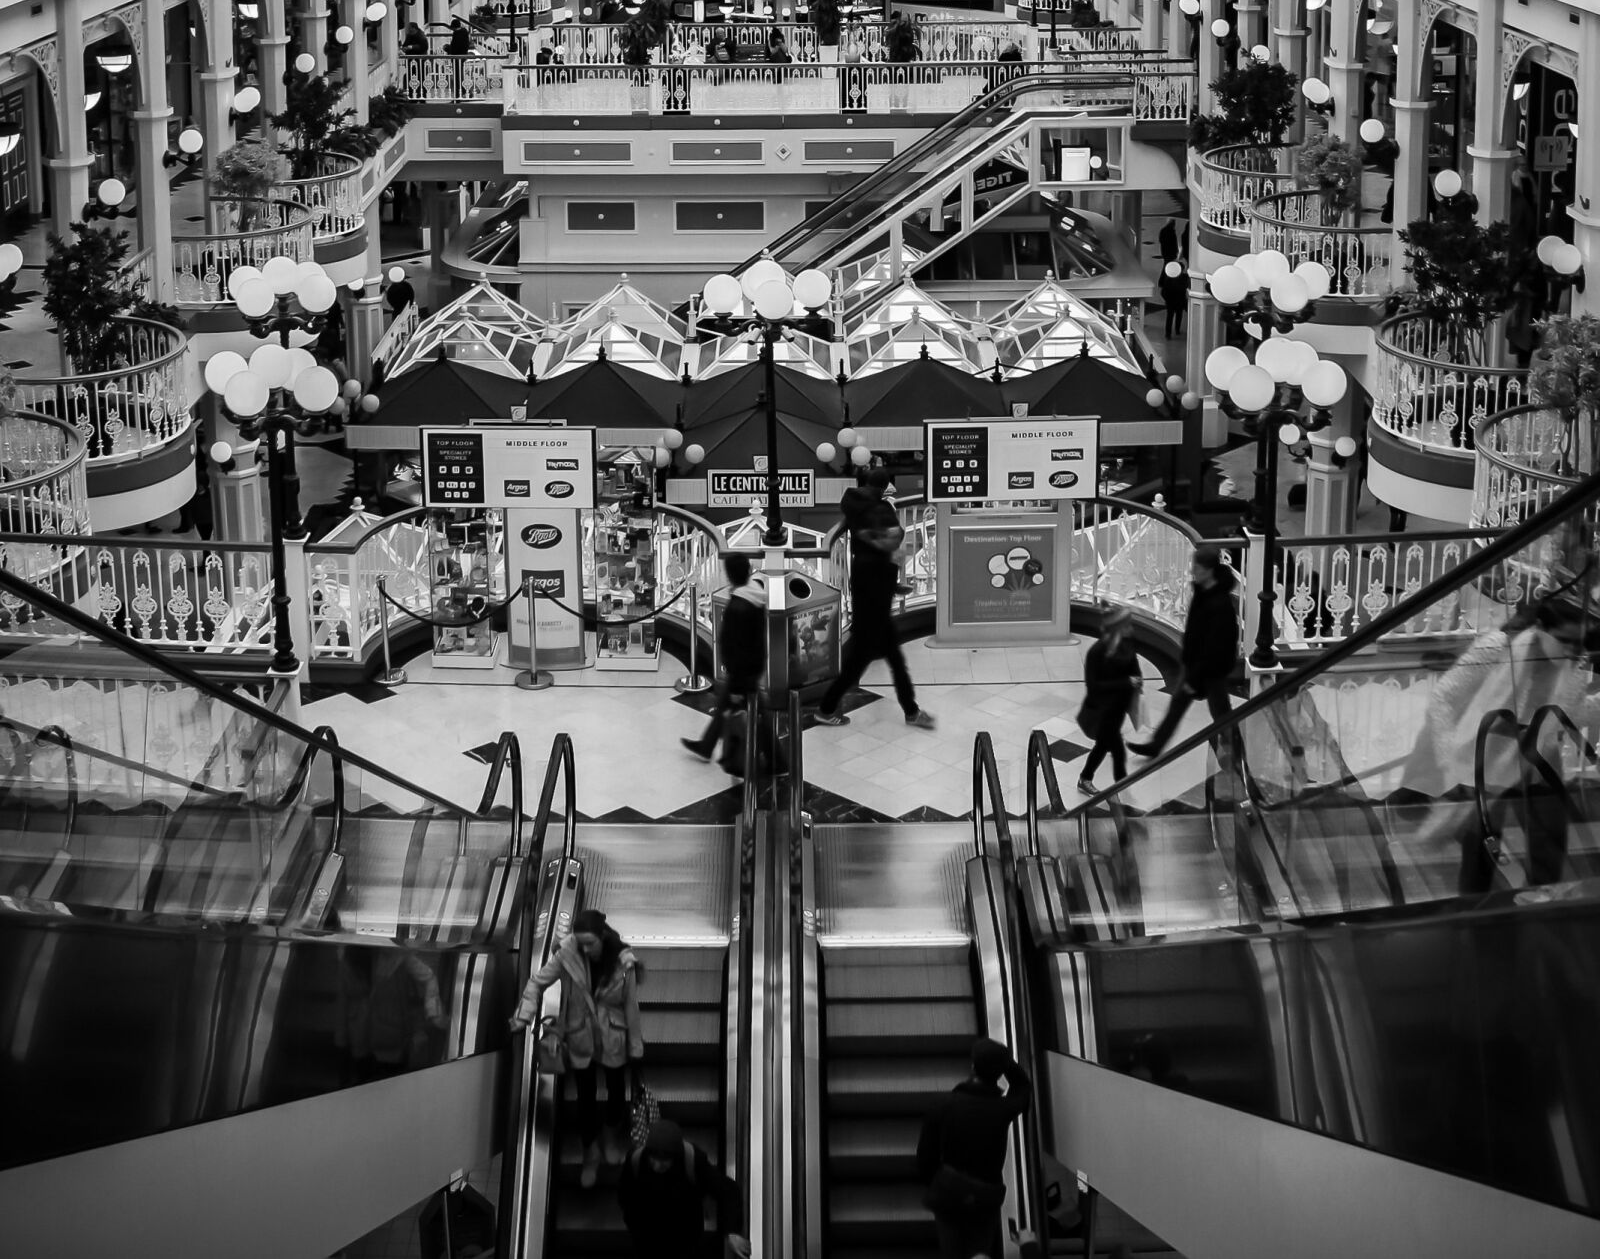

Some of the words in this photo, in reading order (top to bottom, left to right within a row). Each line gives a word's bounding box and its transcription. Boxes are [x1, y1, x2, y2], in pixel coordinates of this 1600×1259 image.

[1011, 431, 1044, 439] MIDDLE
[1046, 430, 1074, 438] FLOOR
[714, 476, 727, 492] LE
[729, 476, 769, 492] CENTR
[1010, 475, 1032, 484] Argos
[506, 483, 528, 492] Argos
[1023, 533, 1042, 542] Floor
[524, 577, 561, 589] rgos
